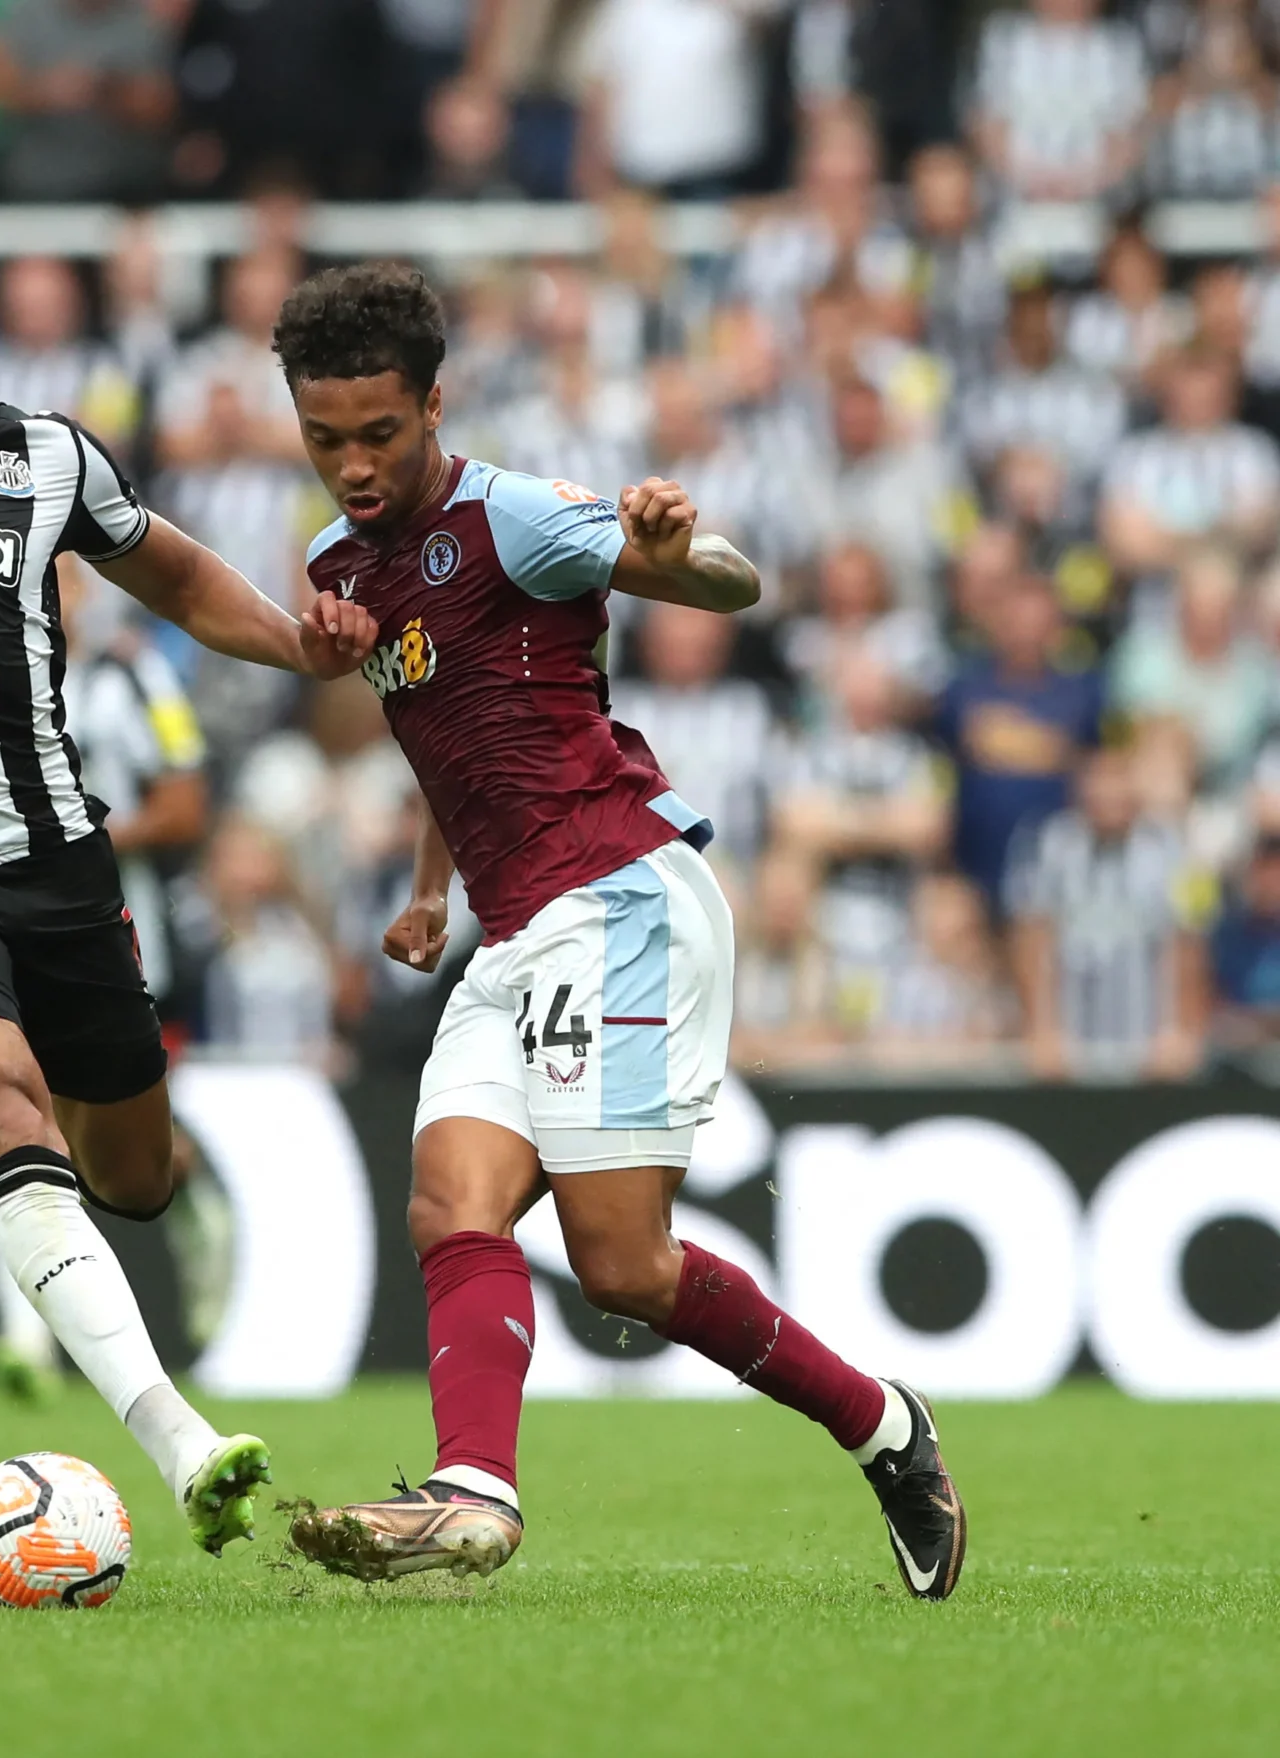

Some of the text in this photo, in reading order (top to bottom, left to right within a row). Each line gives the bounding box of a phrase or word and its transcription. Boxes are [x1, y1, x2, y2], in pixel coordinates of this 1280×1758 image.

[363, 617, 431, 699] BK8
[515, 984, 593, 1065] 44
[34, 1255, 97, 1293] NUFC
